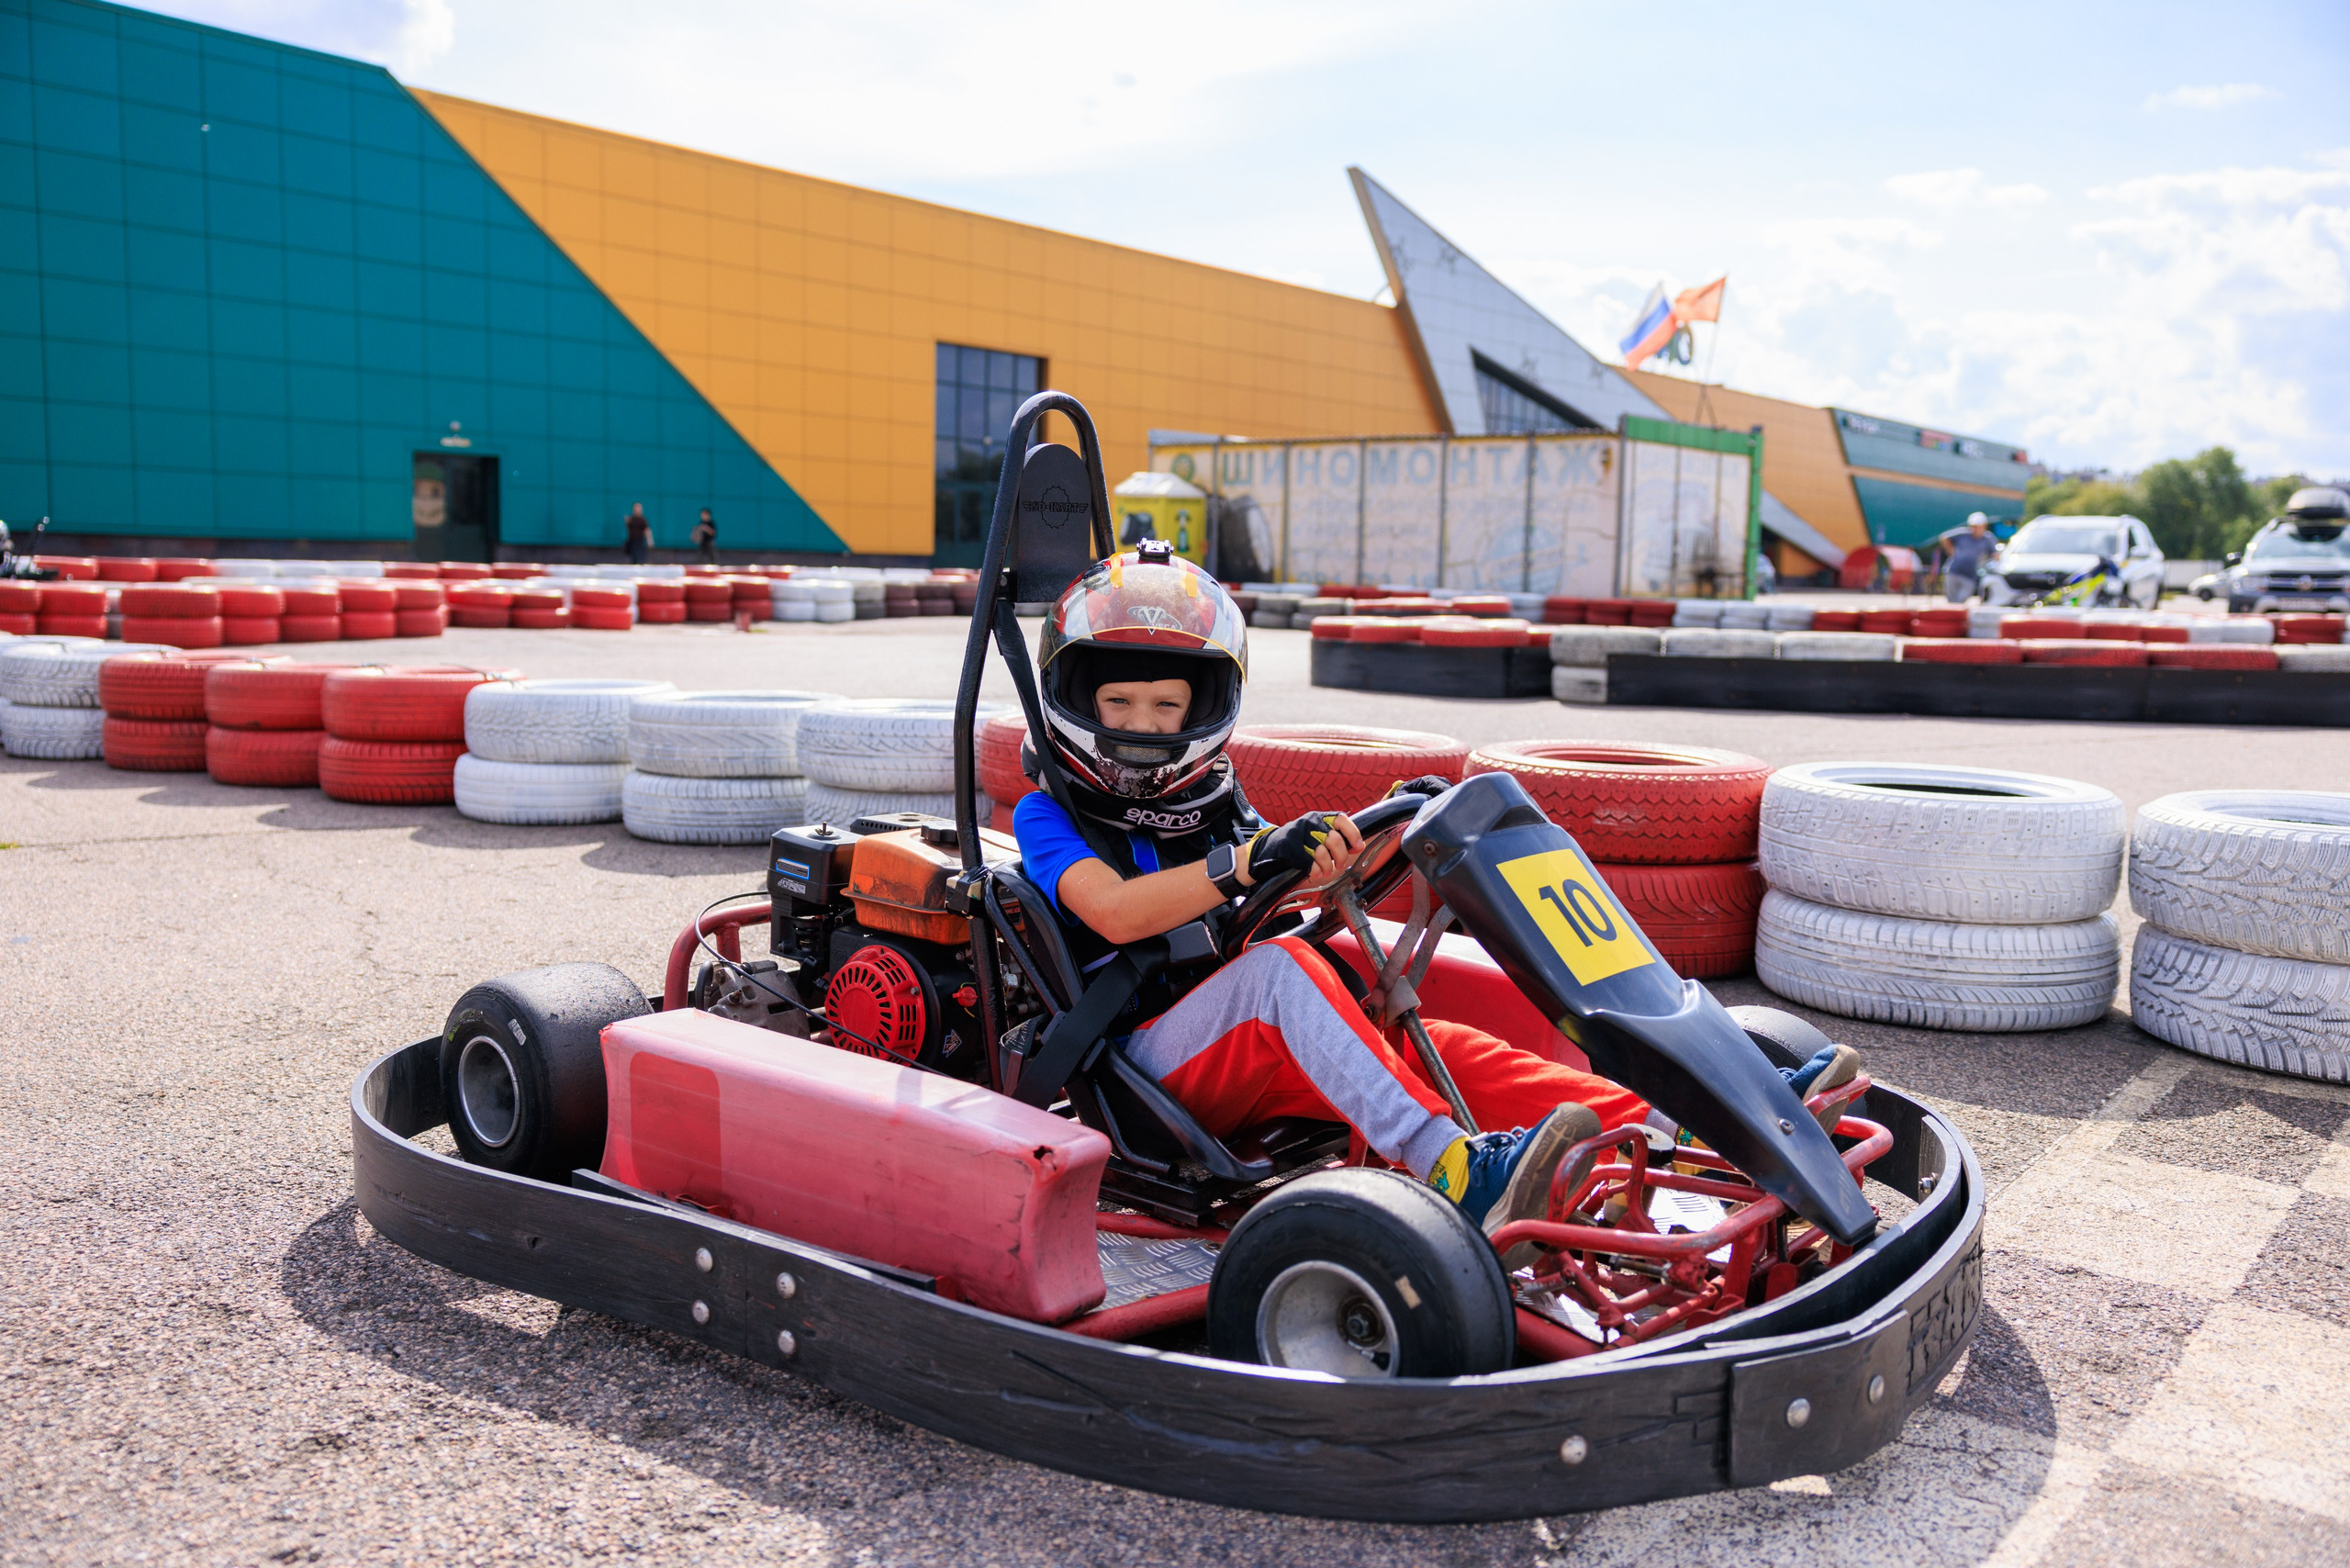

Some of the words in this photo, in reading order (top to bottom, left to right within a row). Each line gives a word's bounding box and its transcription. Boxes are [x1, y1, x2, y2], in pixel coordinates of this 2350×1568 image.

[1222, 445, 1601, 486] ШИНОМОНТАЖ
[1030, 501, 1080, 513] SD-KART
[1125, 808, 1202, 828] sparco
[1539, 879, 1617, 947] 10
